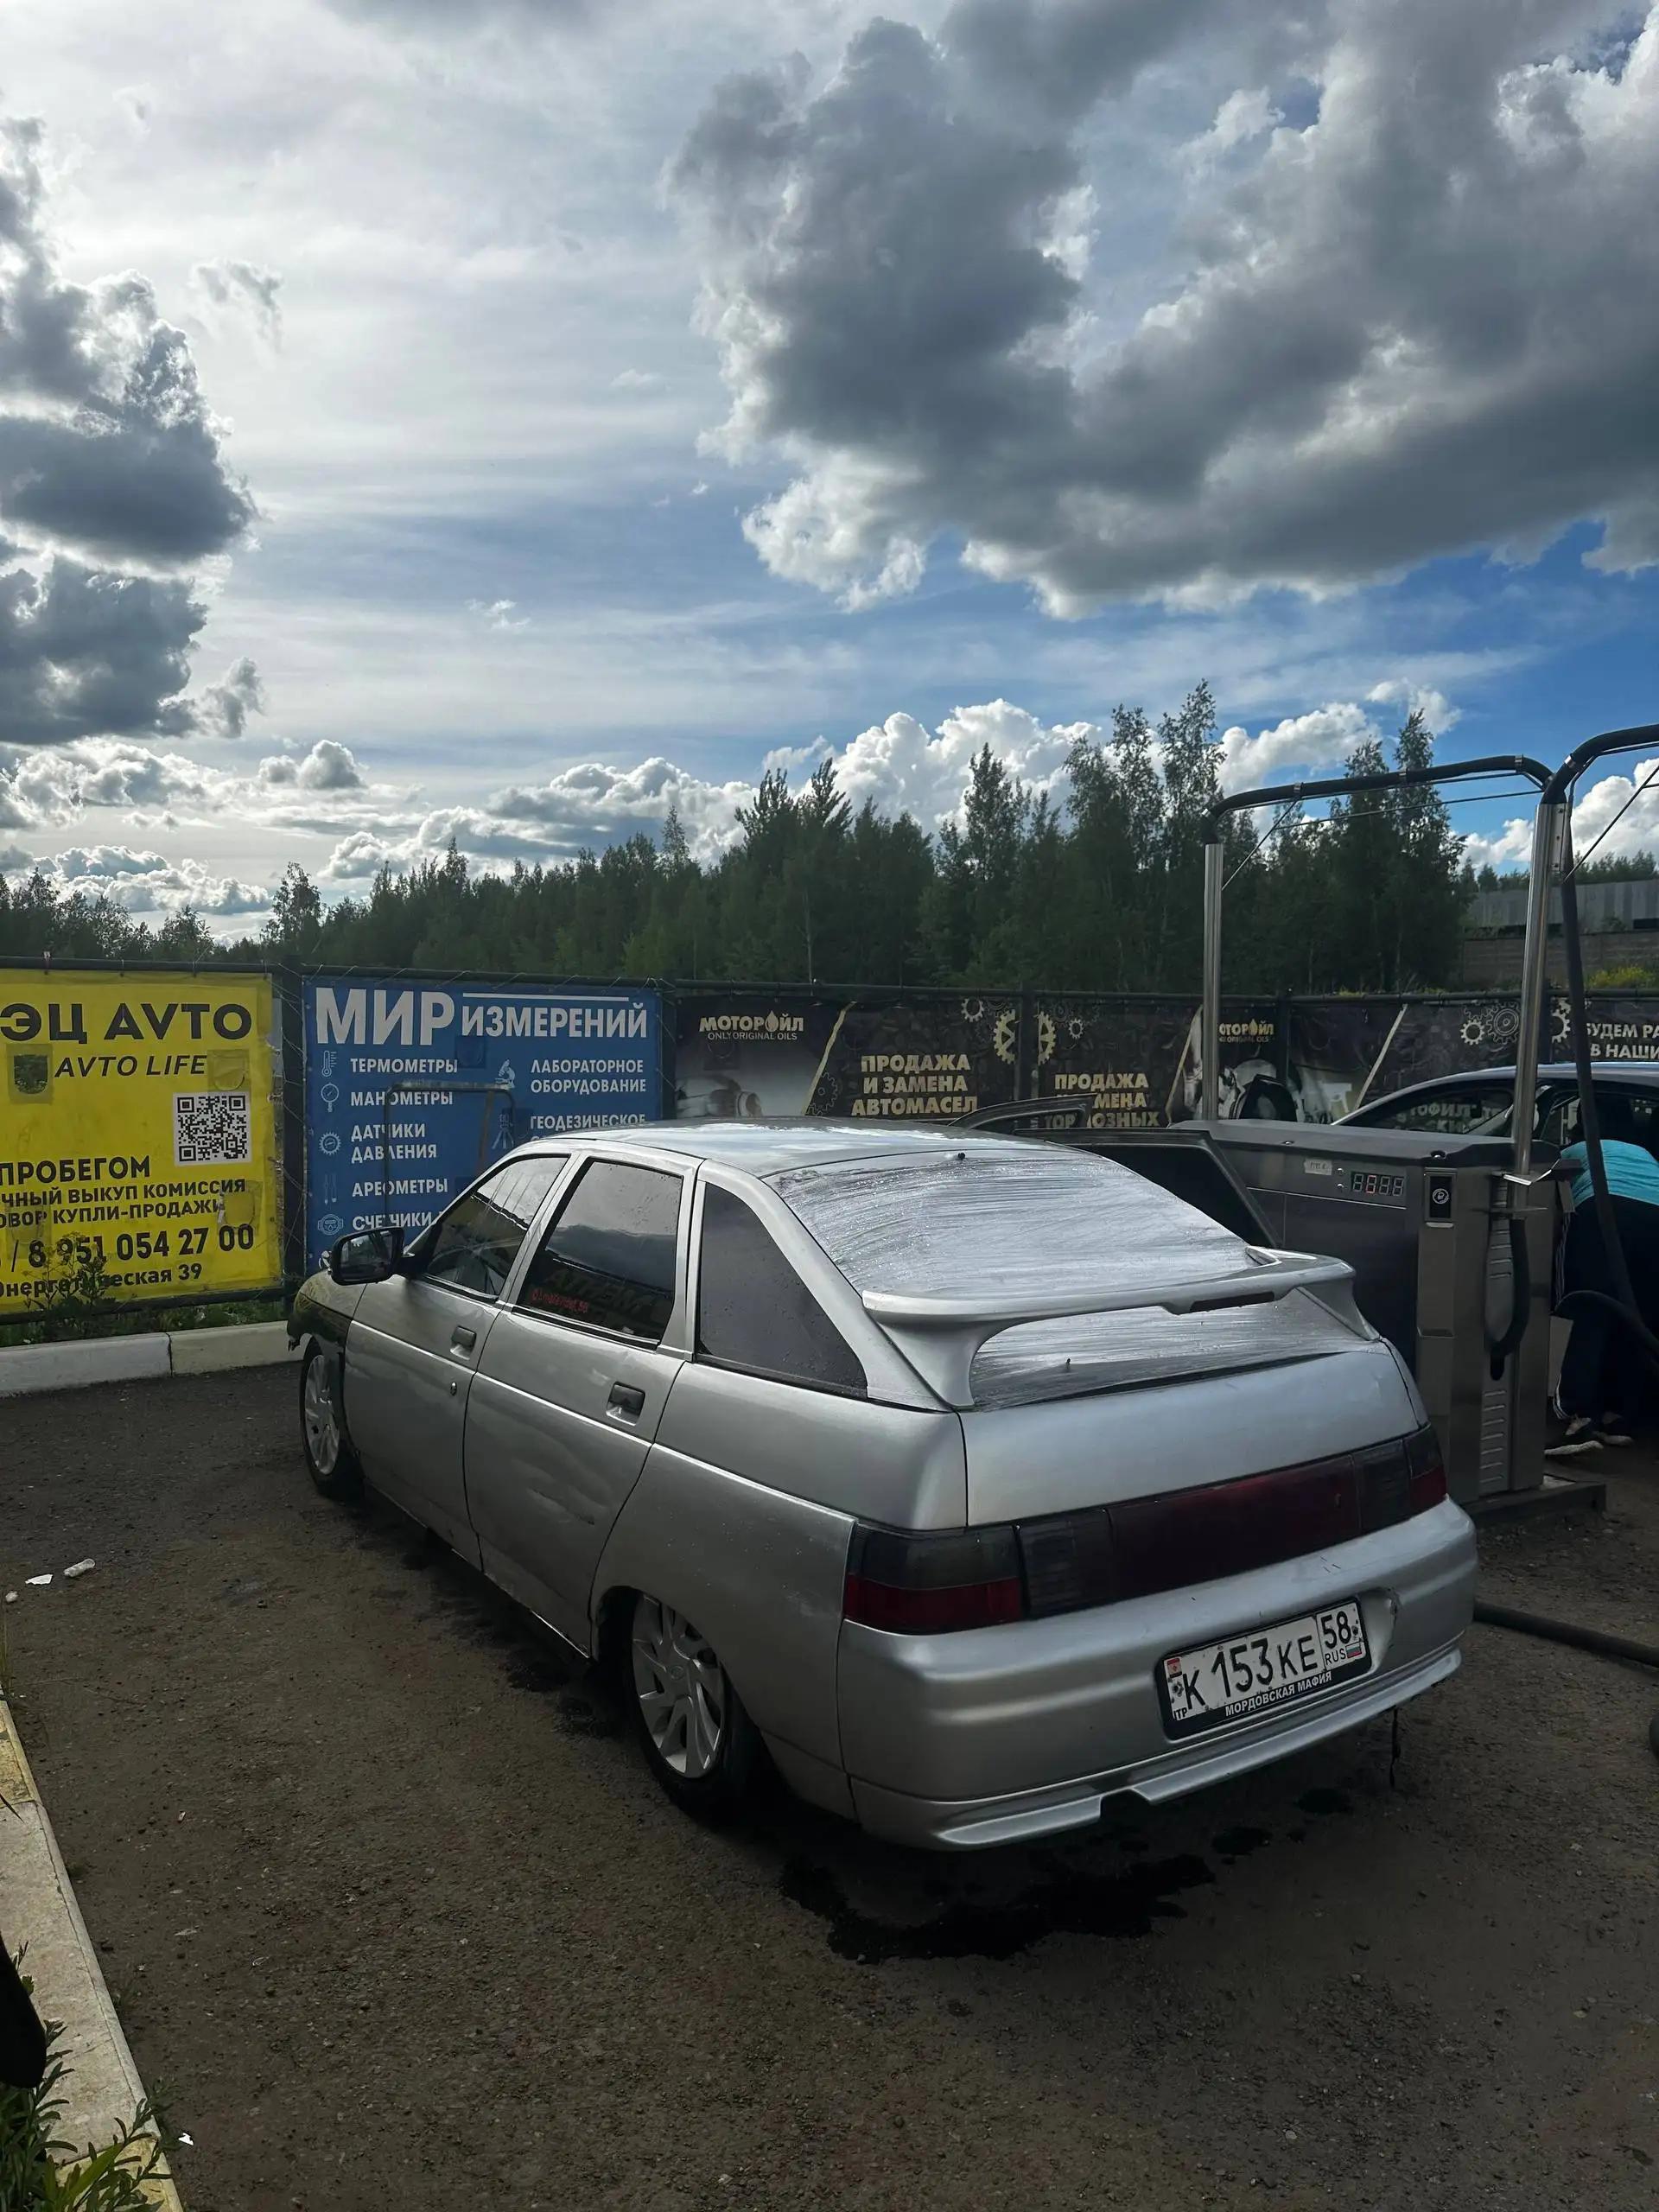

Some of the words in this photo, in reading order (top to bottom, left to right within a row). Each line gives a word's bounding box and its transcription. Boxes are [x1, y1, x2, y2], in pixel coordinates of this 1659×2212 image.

[104, 1003, 252, 1040] AVTO
[316, 988, 455, 1046] МИР
[461, 1002, 647, 1039] ИЗМЕРЕНИЙ
[54, 1055, 138, 1078] AVTO
[146, 1054, 208, 1076] LIFE
[350, 1058, 458, 1074] ТЕРМОМЕТРЫ
[531, 1059, 644, 1074] ЛАБОРАТОРНОЕ
[861, 1054, 970, 1074] ПРОДАЖА
[531, 1078, 647, 1095] ОБОРУДОВАНИЕ
[863, 1077, 878, 1094] И
[882, 1075, 968, 1093] ЗАМЕНА
[1054, 1072, 1149, 1091] ПРОДАЖА
[350, 1090, 454, 1107] МАНОМЕТРЫ
[851, 1095, 978, 1116] АВТОМАСЕЛ
[530, 1113, 646, 1131] ГЕОДЕЗИЧЕСКОЕ
[1044, 1111, 1160, 1128] ТОРОЗНЫХ
[0, 1155, 150, 1185] ПРОБЕГОМ
[68, 1185, 137, 1204] ВЫКУП
[144, 1179, 246, 1198] КОМИССИЯ
[352, 1178, 448, 1198] АРЕОМЕТРЫ
[353, 1211, 432, 1231] СЧЕЧИКИ
[29, 1239, 46, 1268] 8
[117, 1230, 169, 1261] 054
[178, 1227, 209, 1256] 27
[219, 1224, 254, 1252] 00
[178, 1262, 203, 1281] 39
[1320, 1611, 1352, 1649] 58
[1325, 1648, 1346, 1666] RUS
[1225, 1684, 1295, 1717] МОРДОВСКАЯ
[1297, 1670, 1332, 1694] МАФИЯ
